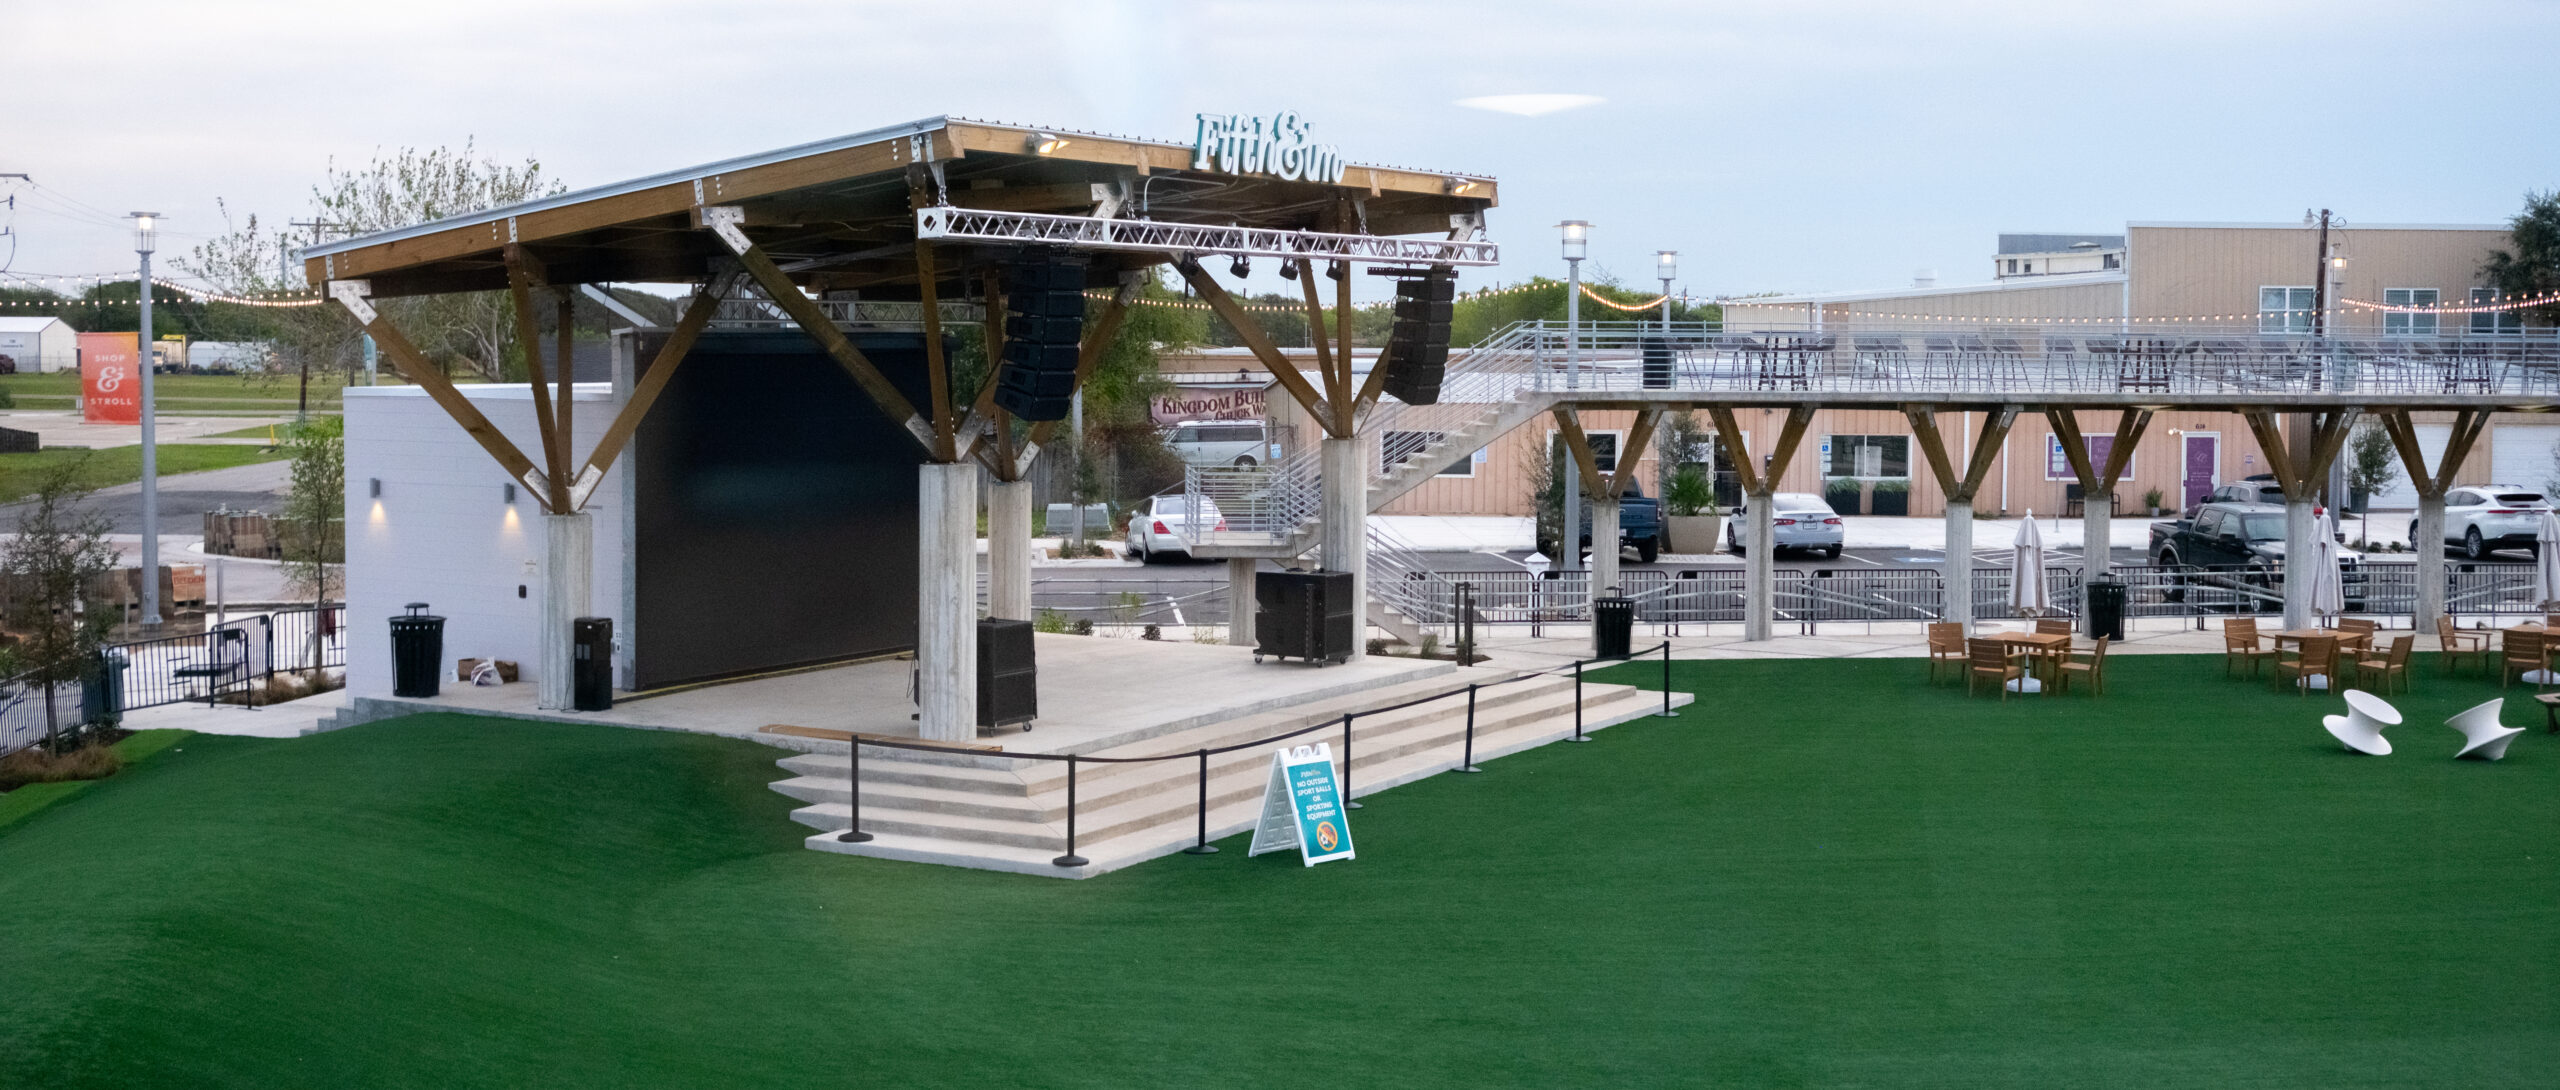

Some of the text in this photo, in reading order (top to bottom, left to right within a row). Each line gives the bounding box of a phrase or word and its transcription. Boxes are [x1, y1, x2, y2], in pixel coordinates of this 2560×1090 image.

[95, 354, 125, 363] SHOP
[96, 366, 124, 393] &
[90, 397, 132, 406] STROLL
[1162, 396, 1230, 415] KINGDOM
[1215, 408, 1250, 420] CHUCK
[1297, 776, 1329, 788] NO OUTSIDE
[1297, 784, 1332, 797] SPORT BALLS
[1306, 801, 1333, 812] SPORTING
[1307, 809, 1336, 820] EQUIPMENT
